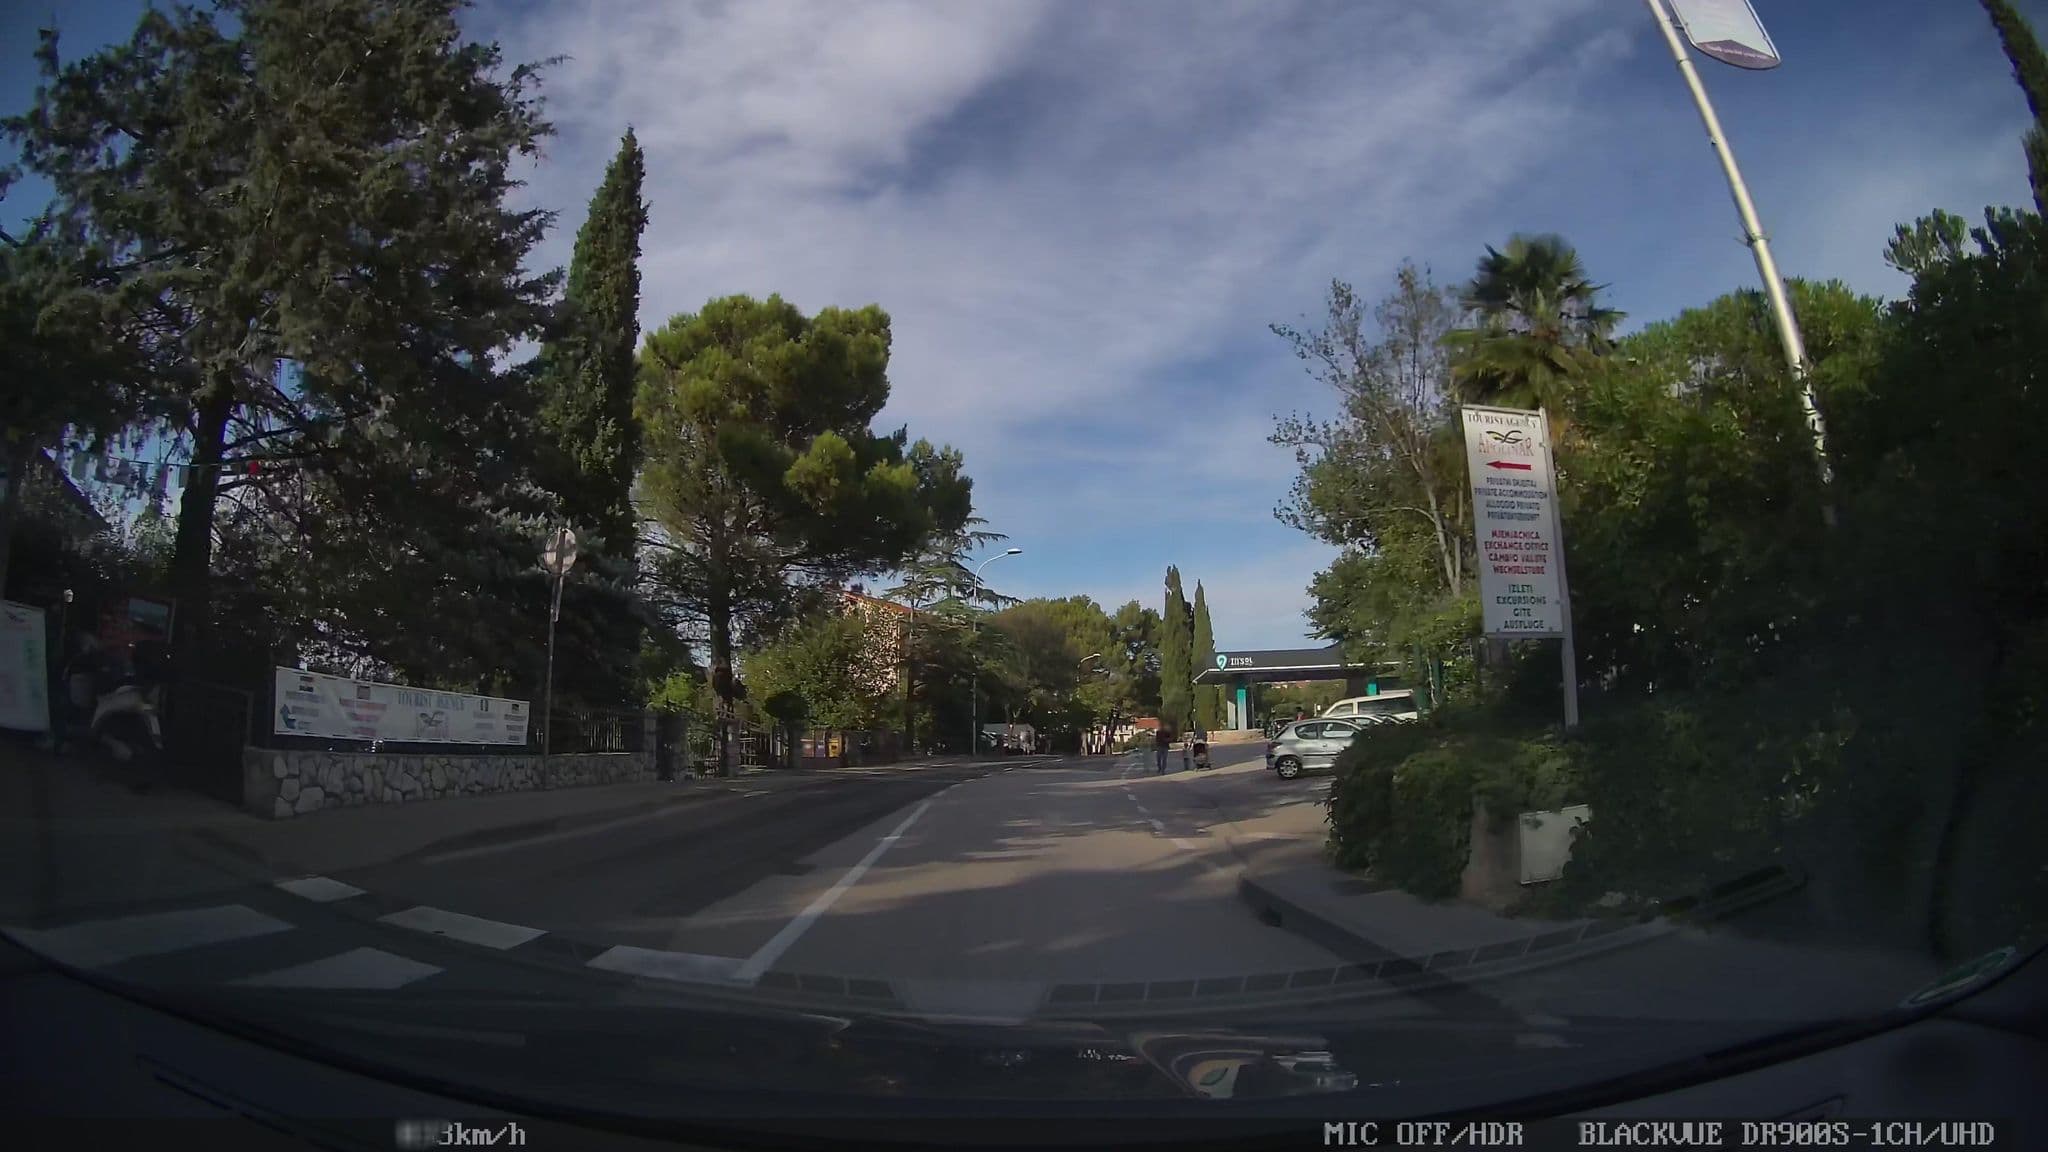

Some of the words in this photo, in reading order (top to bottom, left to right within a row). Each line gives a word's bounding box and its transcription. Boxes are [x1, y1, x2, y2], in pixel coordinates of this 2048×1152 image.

[1468, 413, 1503, 425] TOURIST
[1484, 540, 1523, 551] EXCHANGE
[1524, 542, 1549, 551] OFFICE
[1488, 553, 1518, 562] CAMBIO
[1508, 584, 1533, 593] IZLETI
[1496, 596, 1546, 605] EXCURSIONS
[1513, 608, 1532, 617] GITE
